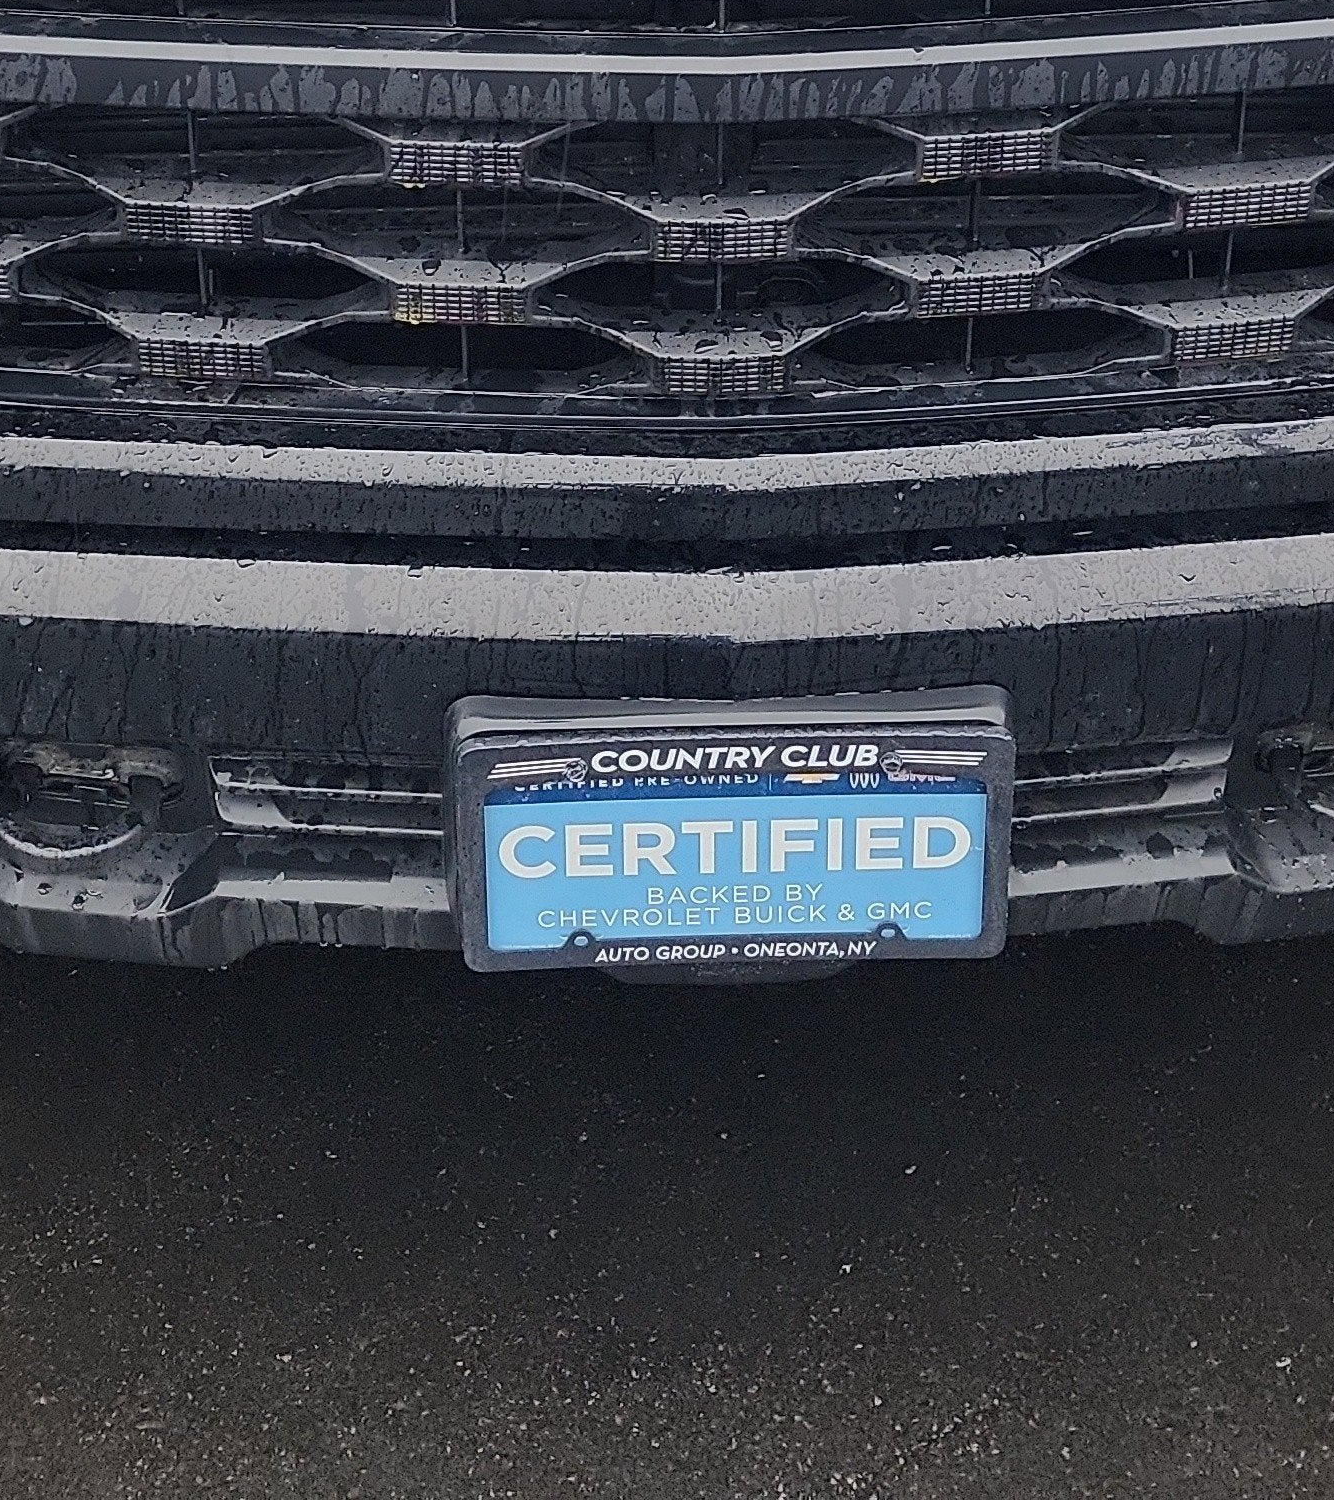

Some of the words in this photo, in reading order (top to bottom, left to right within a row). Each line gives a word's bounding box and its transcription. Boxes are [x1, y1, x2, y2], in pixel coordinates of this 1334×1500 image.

[591, 745, 776, 773] COUNTRY
[780, 744, 878, 768] CLUB
[498, 816, 972, 879] CERTIFIED
[647, 885, 771, 905] BACKED
[785, 883, 824, 901] BY
[537, 907, 721, 928] CHEVROLET
[735, 904, 827, 924] BUICK
[837, 903, 856, 922] &
[867, 901, 933, 920] GMC
[594, 946, 650, 963] AUTO
[655, 944, 726, 960] GROUP
